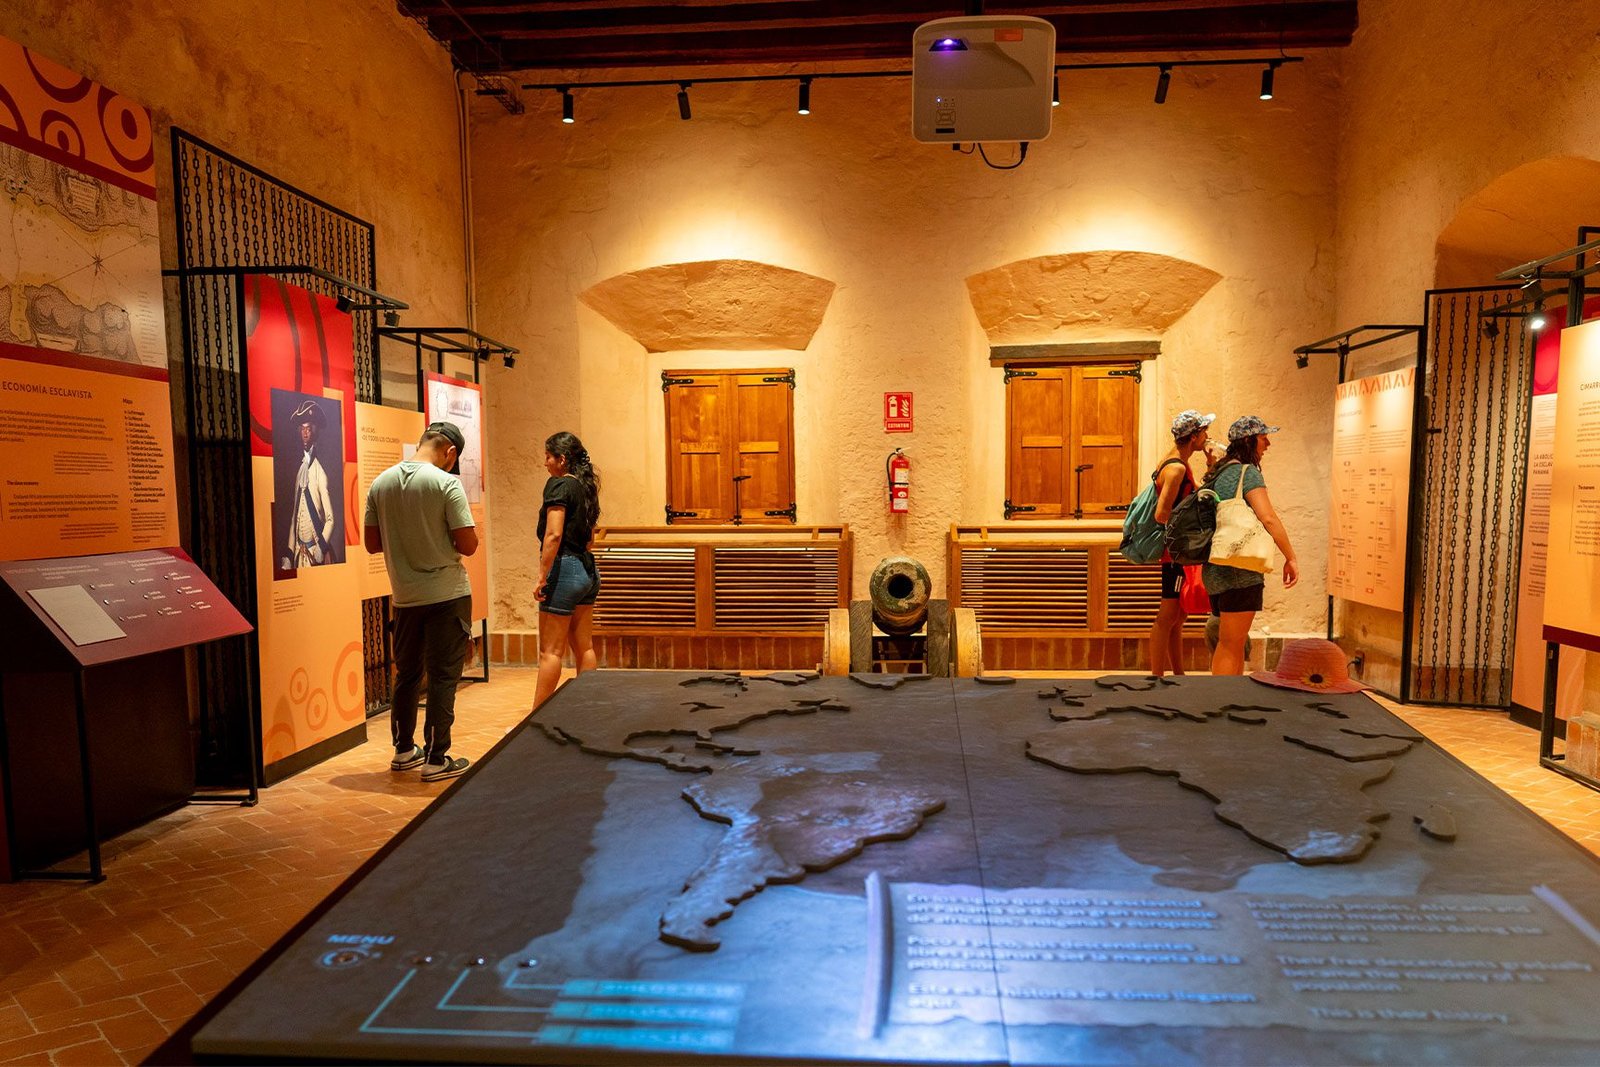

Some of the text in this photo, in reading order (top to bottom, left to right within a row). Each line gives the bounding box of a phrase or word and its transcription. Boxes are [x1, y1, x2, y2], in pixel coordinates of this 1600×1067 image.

[2, 381, 92, 399] ECONOMÍA ESCLAVISTA
[327, 934, 396, 945] MENU
